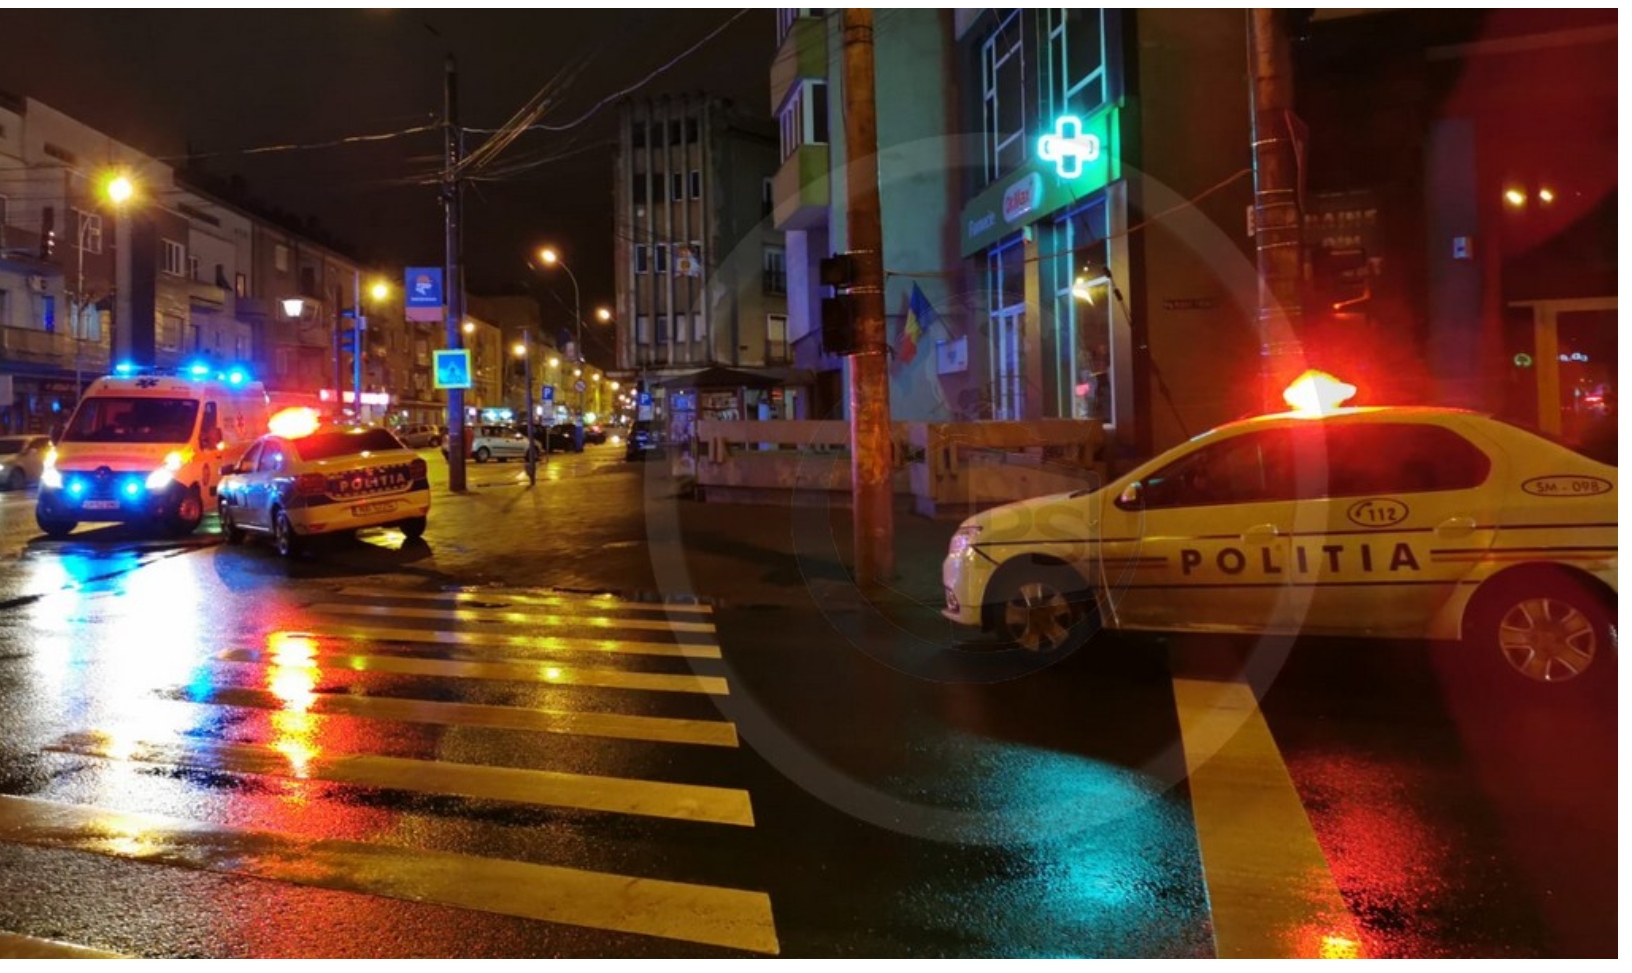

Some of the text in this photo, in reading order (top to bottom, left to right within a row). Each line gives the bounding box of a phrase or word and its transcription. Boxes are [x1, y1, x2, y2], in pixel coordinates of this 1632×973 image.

[340, 473, 406, 492] POLITIA
[1536, 480, 1557, 492] SM
[1369, 507, 1397, 521] 112
[1181, 543, 1421, 576] POLITIA
